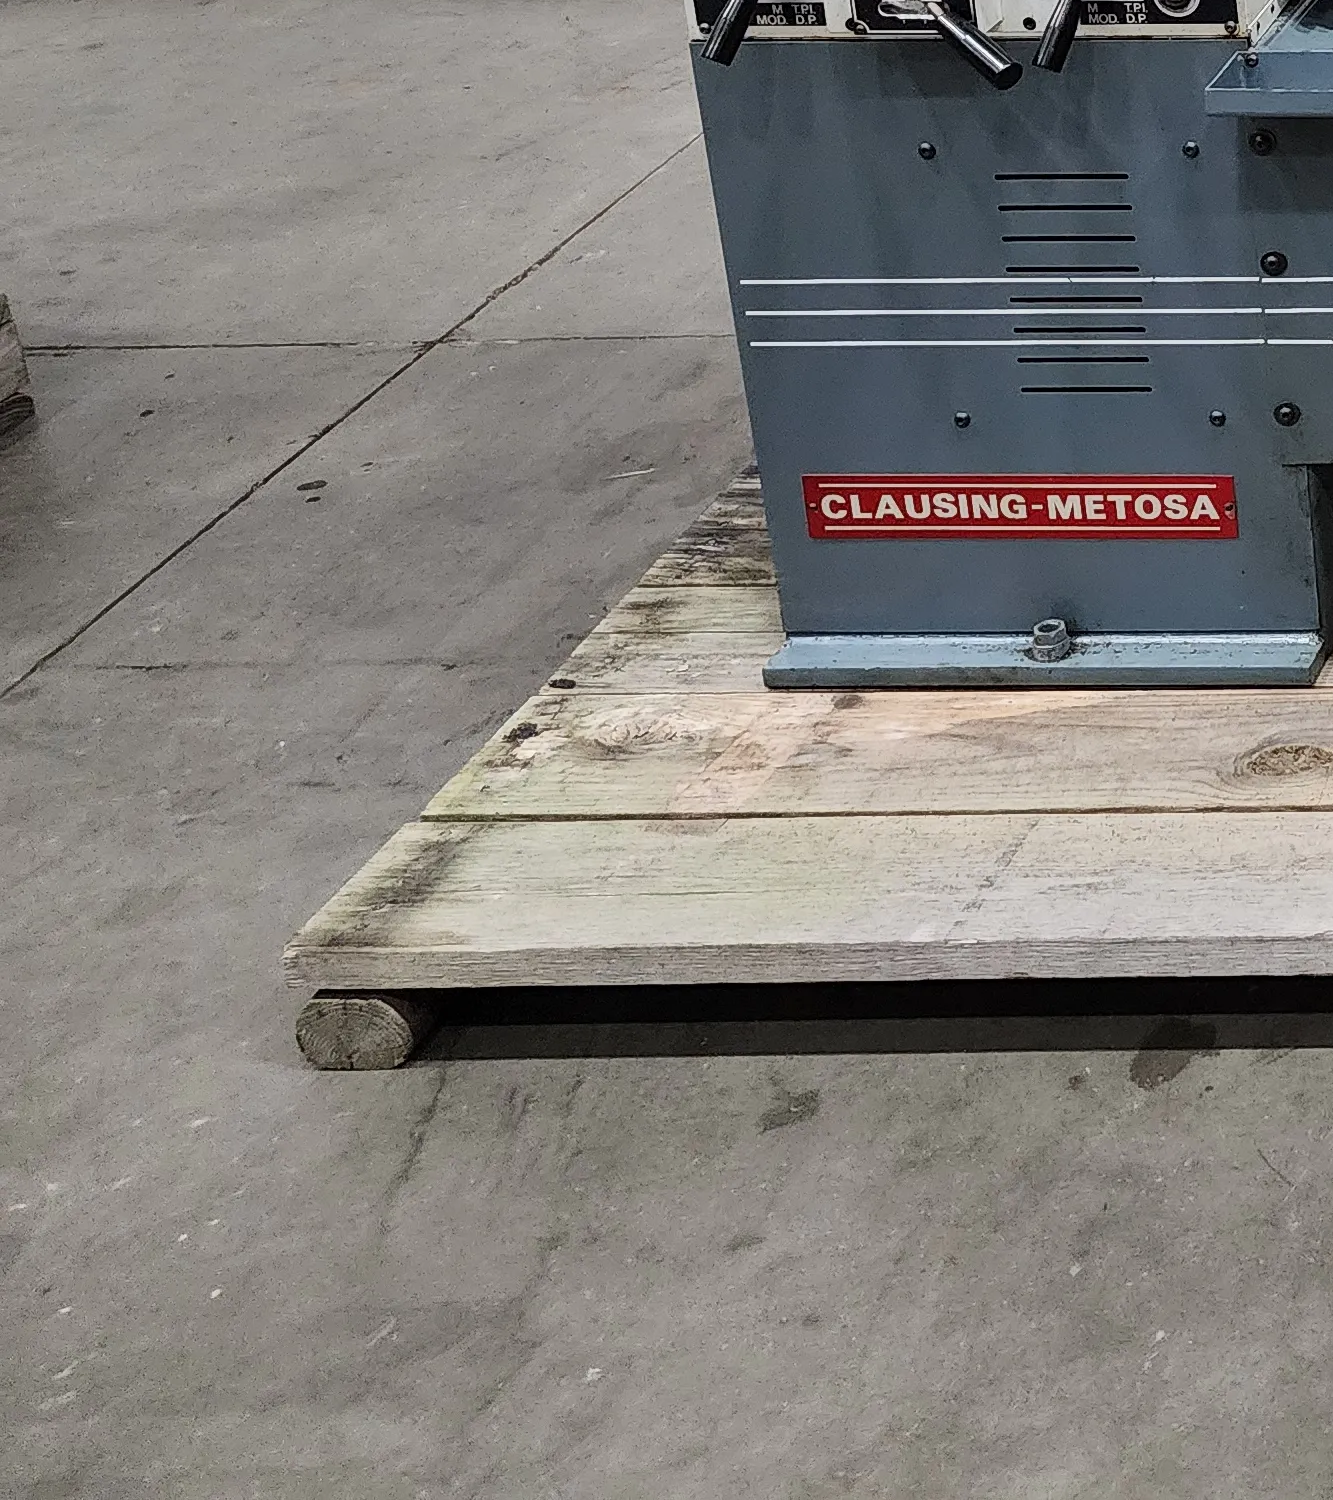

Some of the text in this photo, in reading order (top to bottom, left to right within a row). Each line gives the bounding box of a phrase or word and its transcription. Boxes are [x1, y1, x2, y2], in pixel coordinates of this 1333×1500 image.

[771, 3, 817, 14] M T.P.I.
[1087, 2, 1099, 13] M
[756, 15, 818, 25] MOD. D.P.
[1088, 13, 1148, 24] MOD. D.P.
[821, 493, 1220, 520] CLAUSING-METOSA
